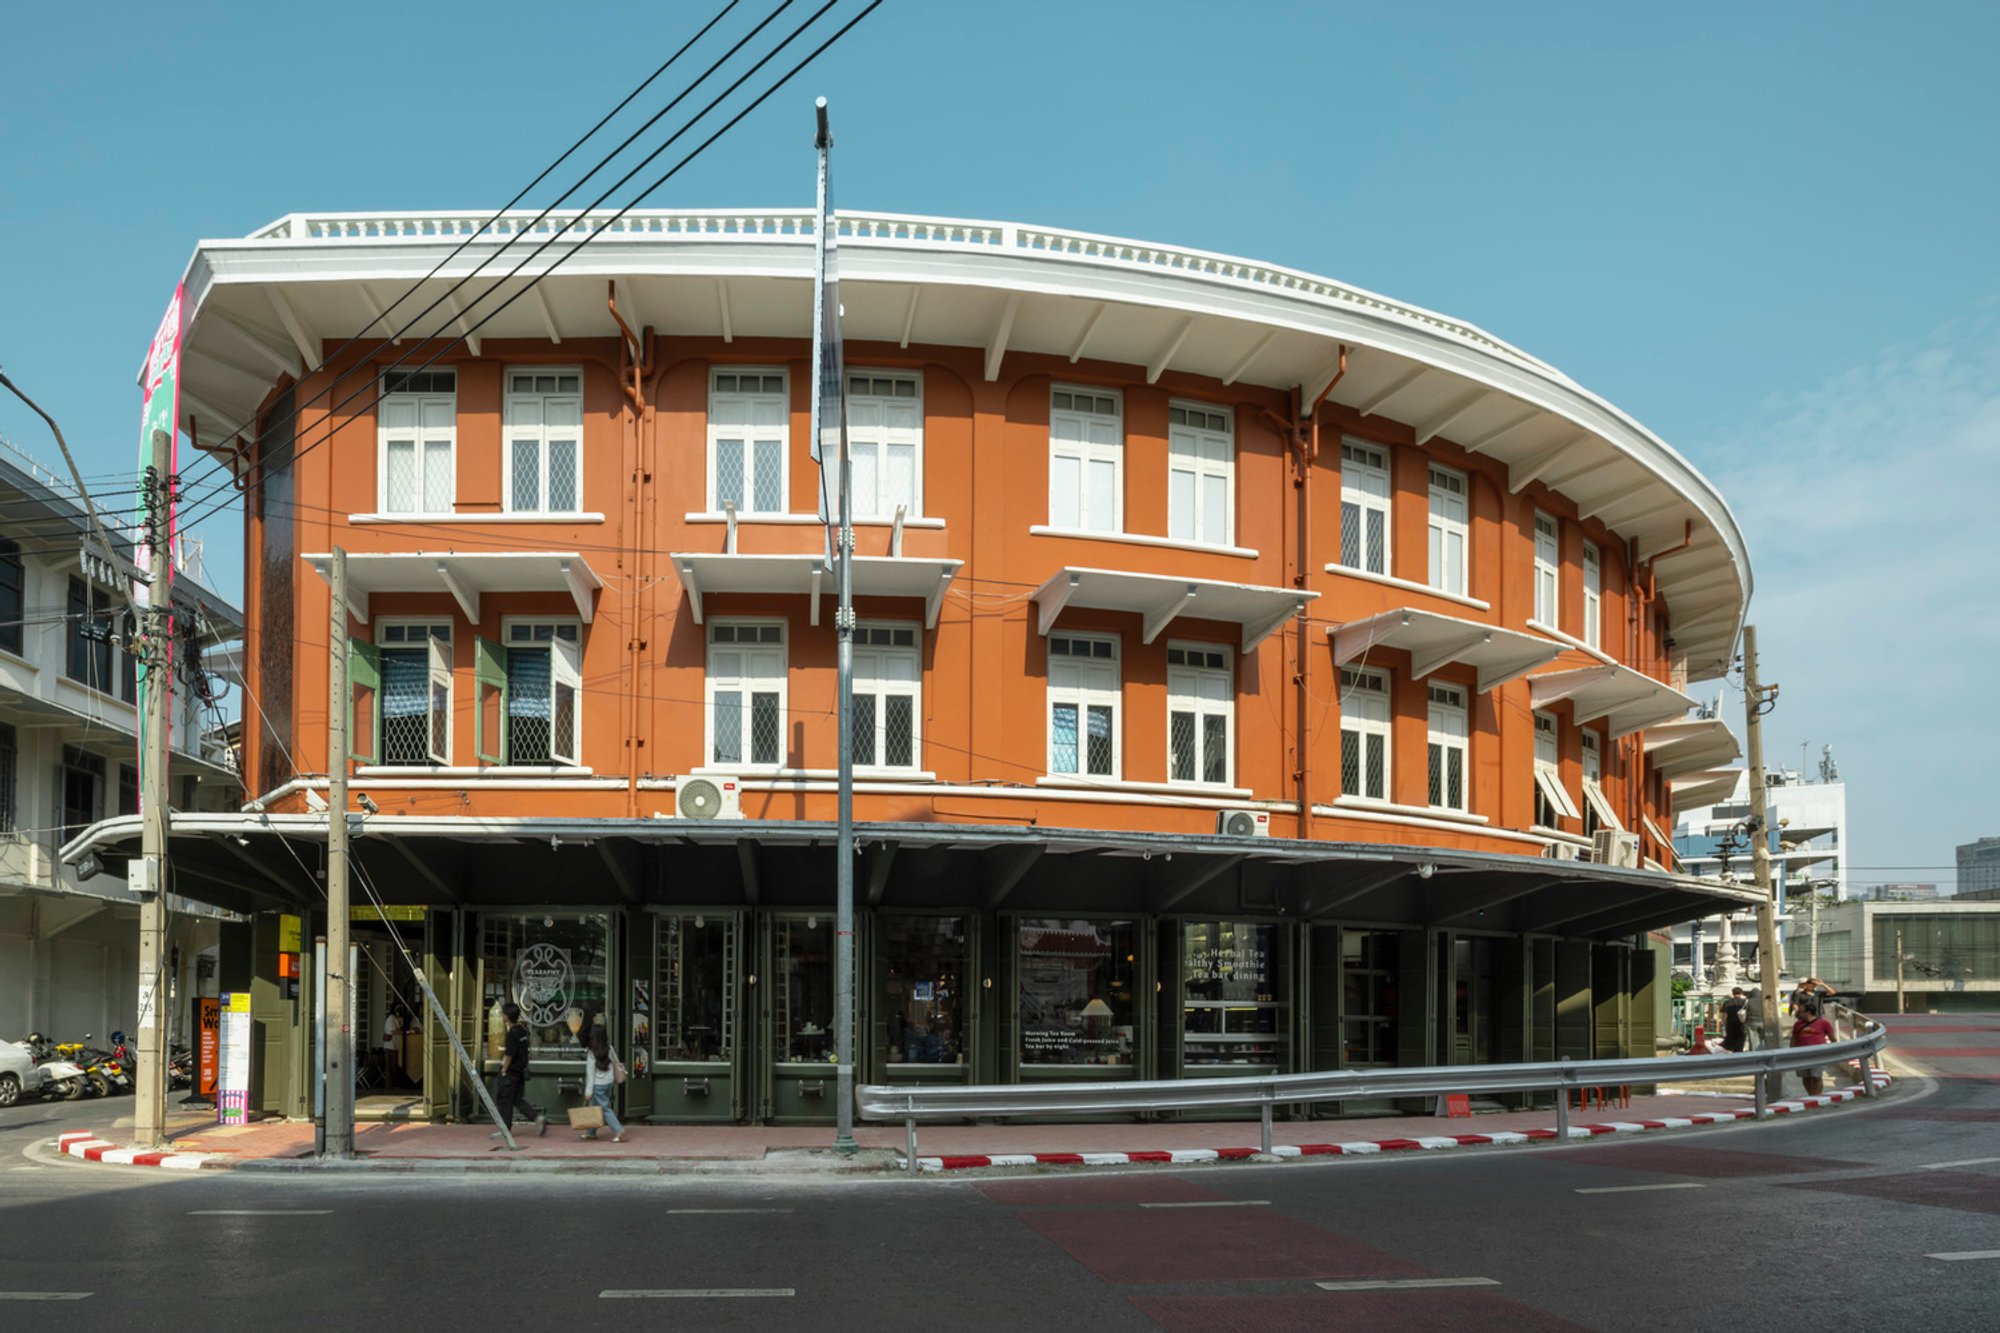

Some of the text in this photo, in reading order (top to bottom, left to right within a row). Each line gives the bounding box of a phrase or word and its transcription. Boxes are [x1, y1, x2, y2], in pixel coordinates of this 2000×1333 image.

[1211, 948, 1245, 958] Herbal
[1248, 949, 1265, 958] Tea
[1217, 958, 1265, 969] Smoothie
[1192, 969, 1209, 979] Tea
[1233, 971, 1265, 982] dining
